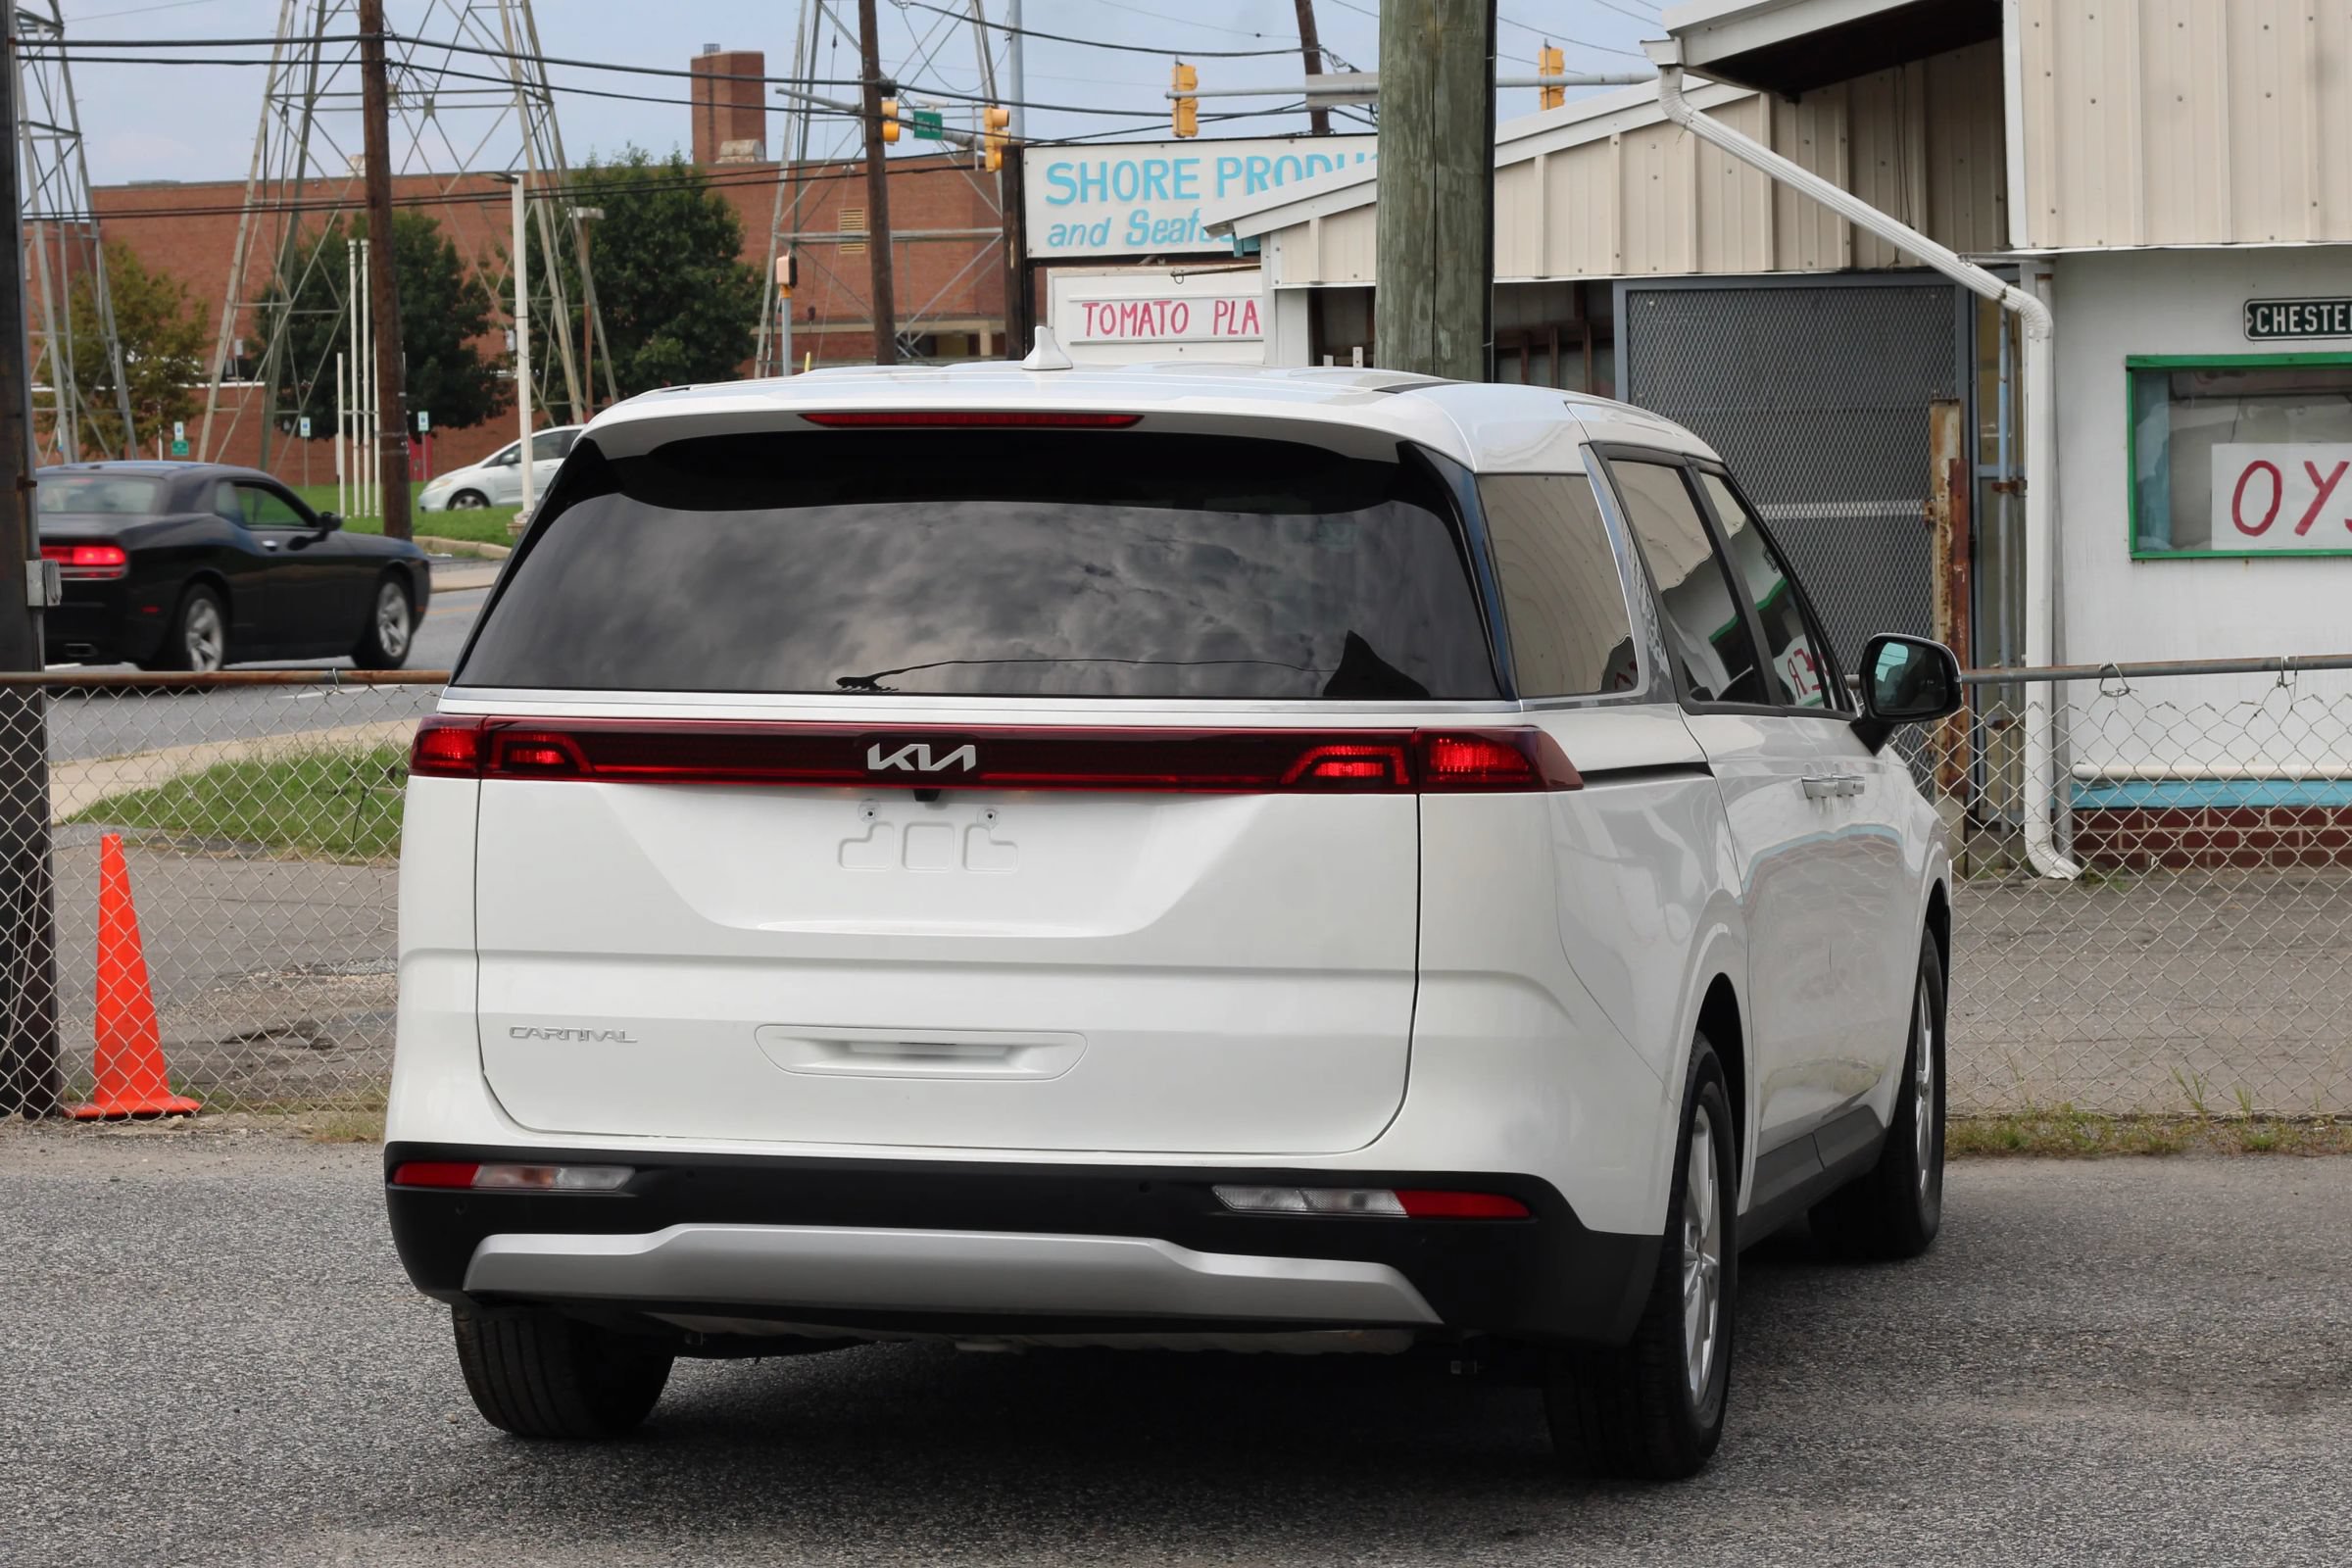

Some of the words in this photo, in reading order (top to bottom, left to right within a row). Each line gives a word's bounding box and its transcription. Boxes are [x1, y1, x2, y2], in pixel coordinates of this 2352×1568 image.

[1045, 157, 1200, 206] SHORE
[1216, 152, 1377, 199] PROD
[1047, 218, 1112, 247] and
[1125, 207, 1234, 247] Seaf
[1081, 300, 1190, 337] TOMATO
[1212, 299, 1259, 336] PLA
[2256, 304, 2352, 333] CHESTE
[2231, 460, 2352, 537] OY
[866, 743, 977, 772] KIA
[509, 1025, 639, 1044] CARNIVAL
